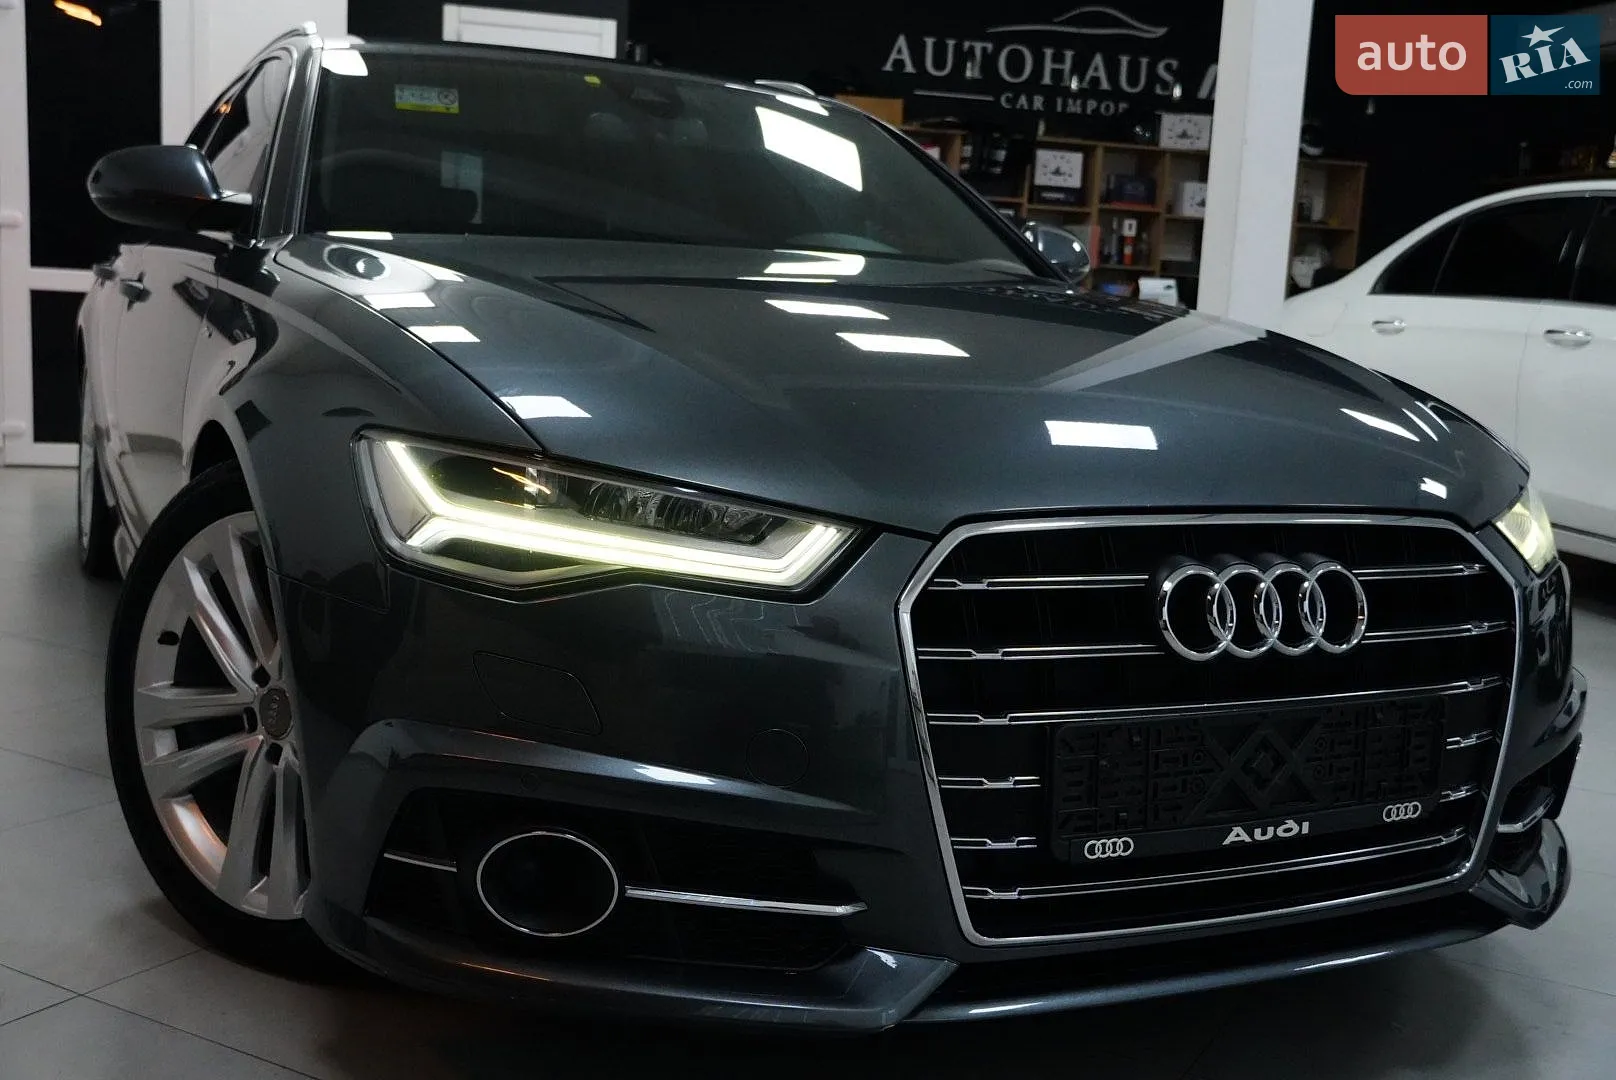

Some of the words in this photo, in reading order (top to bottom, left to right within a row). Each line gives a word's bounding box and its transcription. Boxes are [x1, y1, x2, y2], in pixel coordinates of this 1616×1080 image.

[881, 33, 1180, 96] AUTOHAUS
[1000, 92, 1044, 111] CAR
[1222, 820, 1310, 846] Audi
